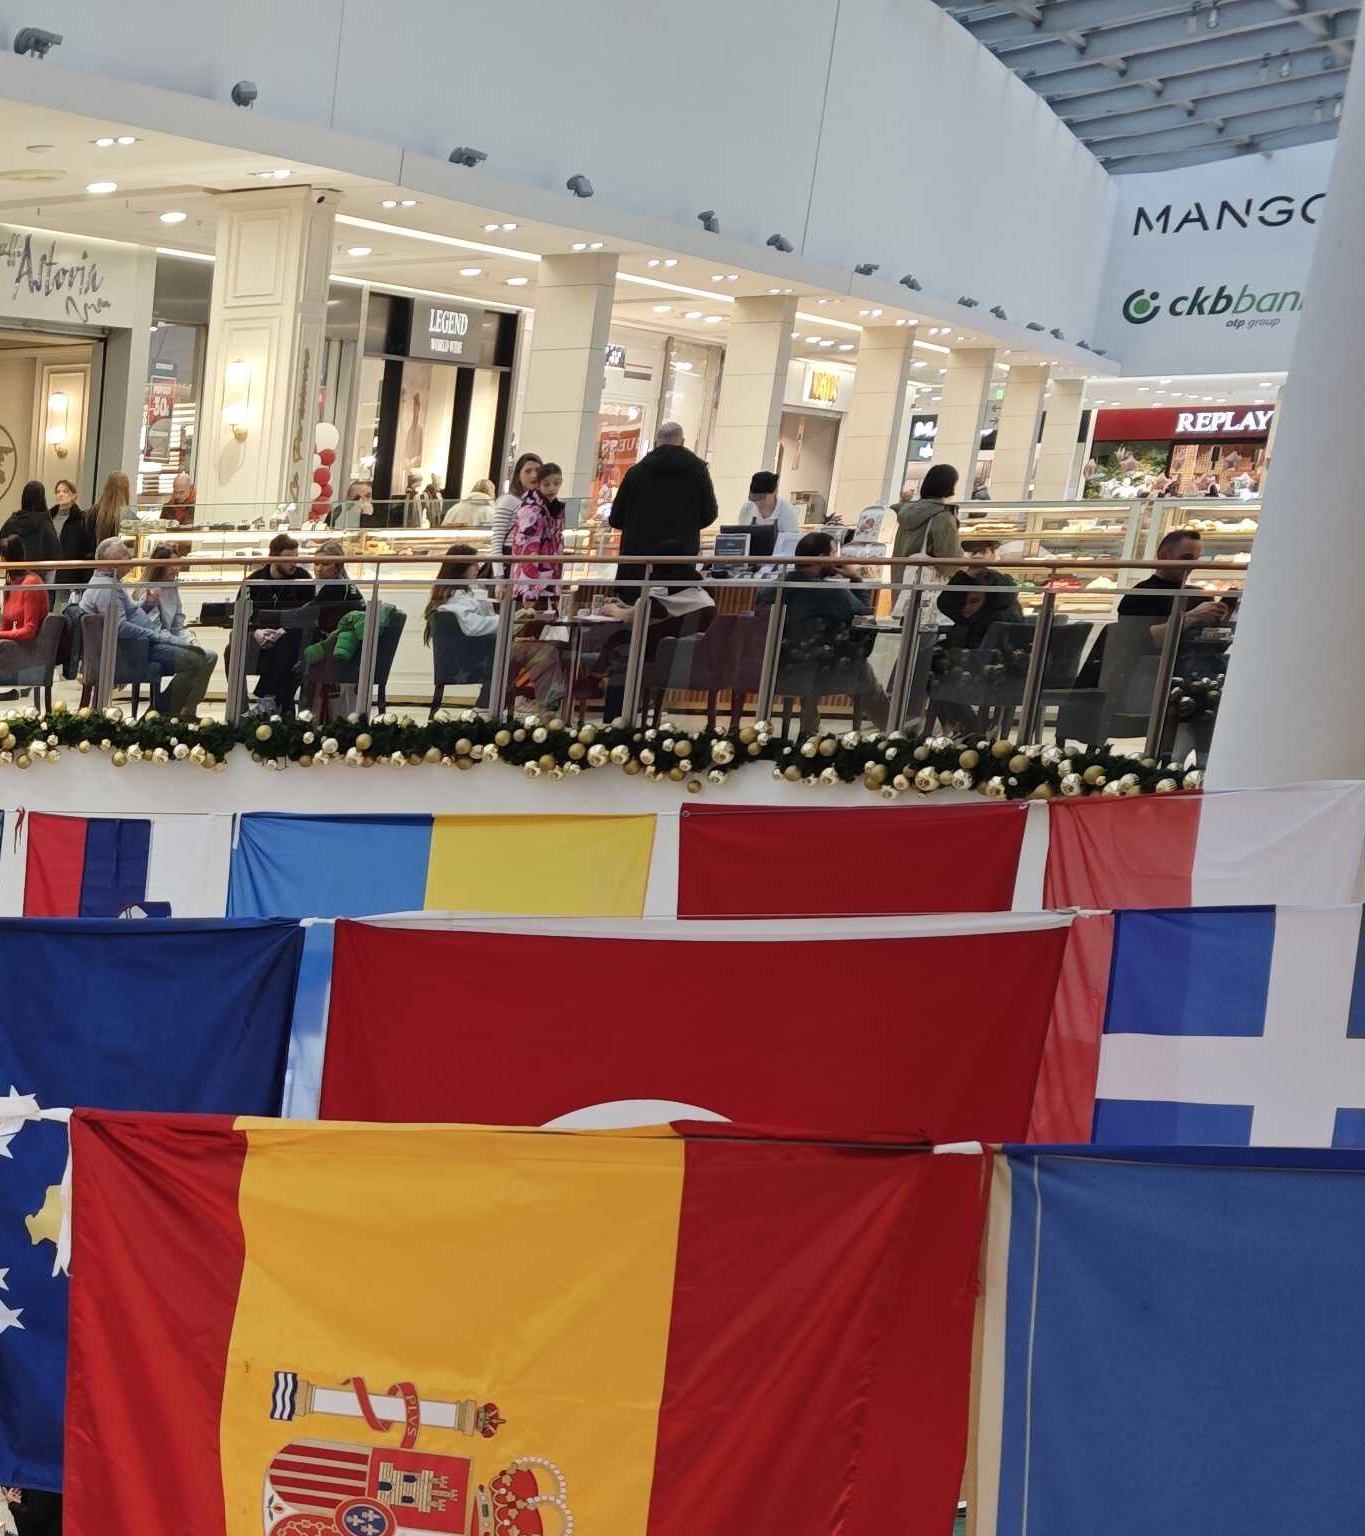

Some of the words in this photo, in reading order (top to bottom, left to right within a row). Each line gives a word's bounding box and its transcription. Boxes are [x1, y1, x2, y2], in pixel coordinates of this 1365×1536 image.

[1169, 284, 1304, 316] ckbban
[429, 309, 468, 336] LEGEND
[1225, 318, 1246, 330] otp
[1247, 318, 1281, 330] group
[1175, 410, 1276, 433] REPLAY
[405, 1394, 418, 1437] PLVS
